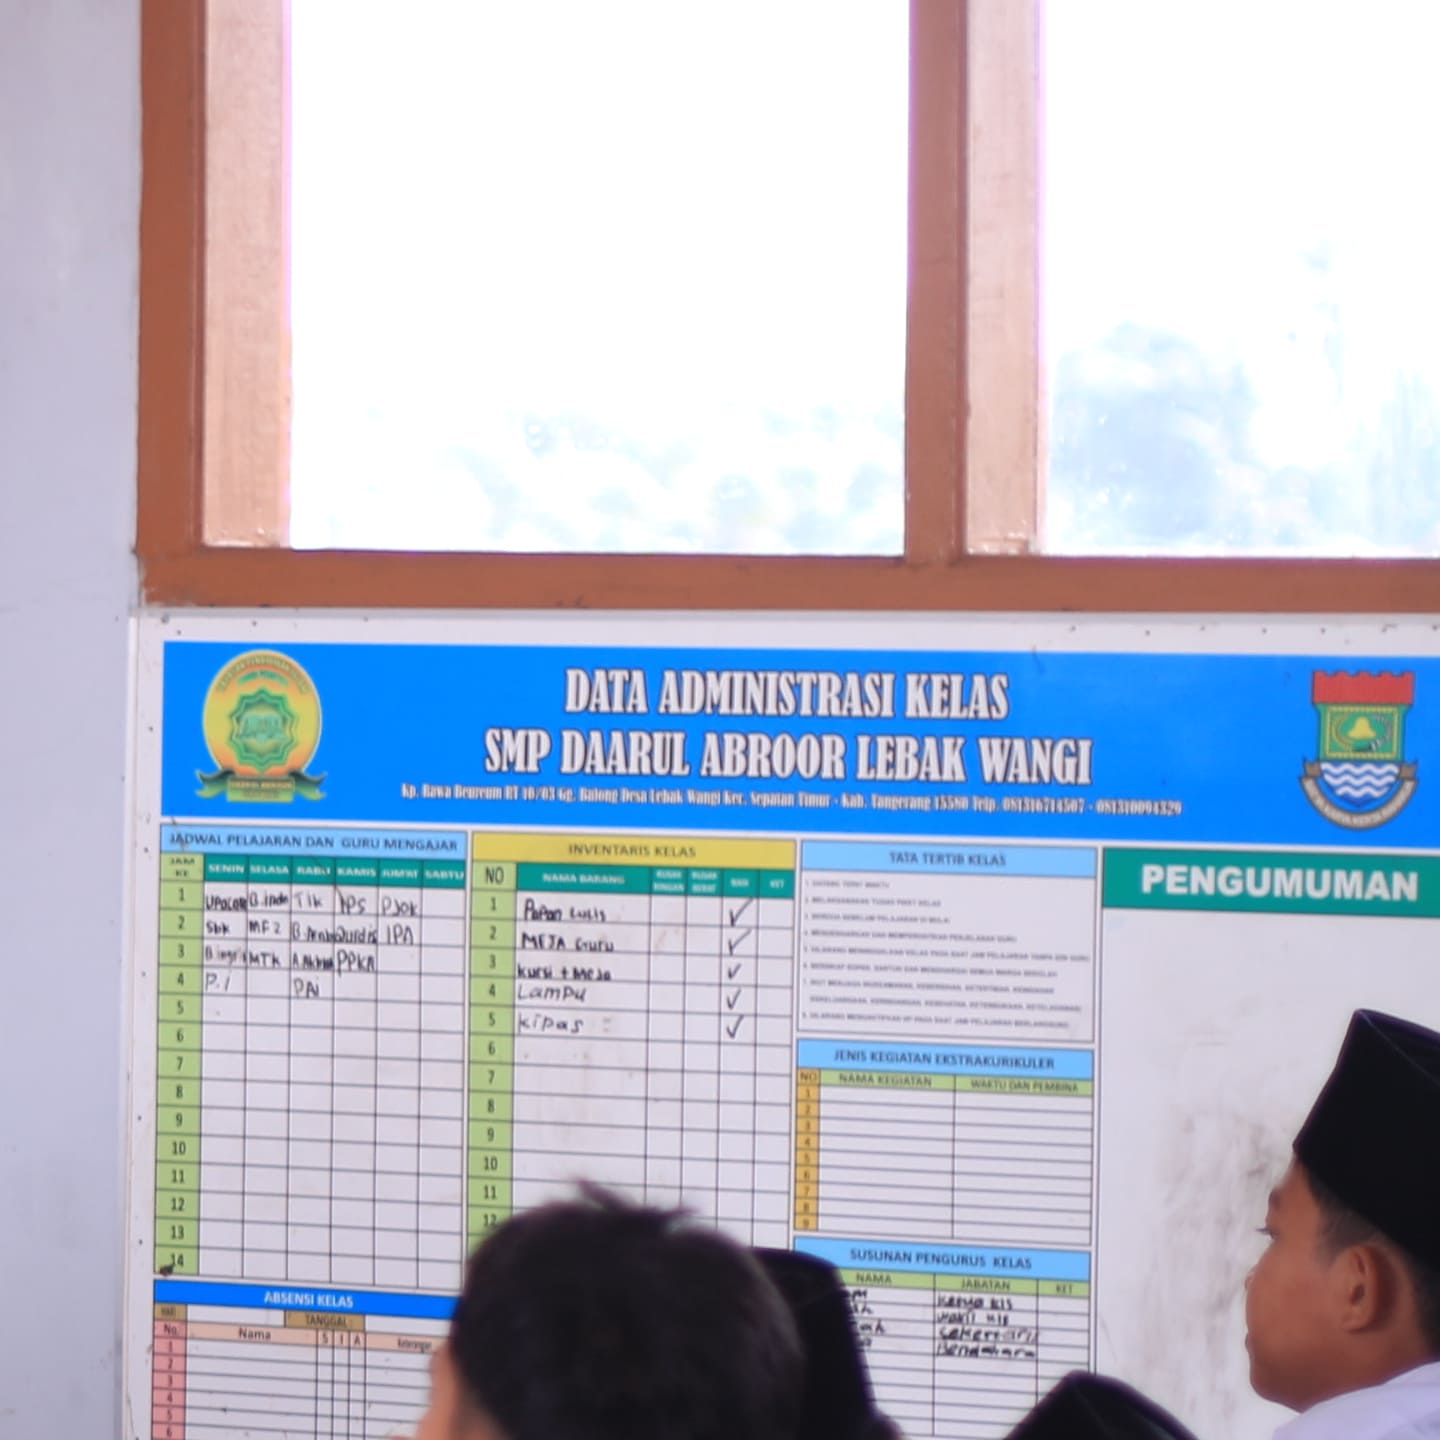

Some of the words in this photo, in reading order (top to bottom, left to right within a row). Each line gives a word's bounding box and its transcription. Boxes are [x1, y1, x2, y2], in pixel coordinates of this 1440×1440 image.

[564, 667, 649, 715] DATA
[658, 669, 896, 719] ADMINISTRASI
[904, 673, 1010, 720] KELAS
[484, 728, 553, 774] SMP
[560, 730, 691, 777] DAARUL
[700, 732, 847, 780] ABROOR
[856, 734, 967, 783] LEBAK
[977, 736, 1094, 785] WANGI
[621, 788, 647, 803] Desa
[650, 788, 683, 804] Lebak
[687, 789, 722, 806] Wangi
[724, 790, 747, 805] Kec.
[750, 790, 795, 808] Sepatan
[798, 791, 831, 807] Timur
[841, 791, 866, 808] Kab.
[871, 793, 932, 811] Tangerang
[170, 832, 223, 847] JADWAL
[227, 834, 303, 848] PELAJARAN
[306, 836, 334, 848] DAN
[341, 837, 380, 849] GURU
[384, 838, 458, 851] MENGAJAR
[569, 844, 650, 857] INVENTARIS
[654, 846, 697, 859] KELAS
[889, 851, 919, 864] TATA
[922, 852, 965, 866] TERTIB
[969, 854, 1007, 867] KELAS
[209, 863, 244, 874] SENIN
[249, 865, 289, 875] SELASA
[337, 868, 377, 878] KAMIS
[425, 870, 466, 881] SABTU
[484, 867, 505, 885] NO
[542, 872, 576, 883] NAMA
[1141, 863, 1419, 902] PENGUMUMAN
[178, 916, 185, 930] 2
[489, 926, 497, 940] 2
[177, 945, 184, 959] 3
[489, 955, 497, 969] 3
[177, 973, 184, 987] 4
[488, 984, 496, 998] 4
[176, 1000, 184, 1014] 5
[488, 1013, 496, 1027] 5
[176, 1029, 184, 1042] 6
[488, 1041, 496, 1055] 6
[176, 1057, 183, 1070] 7
[833, 1049, 867, 1062] JENIS
[870, 1051, 932, 1066] KEGIATAN
[935, 1054, 1056, 1070] EKSTRAKURIKULER
[487, 1070, 495, 1084] 7
[838, 1074, 874, 1085] NAMA
[877, 1076, 932, 1088] KEGIATAN
[176, 1085, 183, 1099] 8
[487, 1099, 495, 1113] 8
[175, 1113, 183, 1127] 9
[487, 1128, 495, 1142] 9
[171, 1141, 186, 1155] 10
[483, 1156, 498, 1170] 10
[171, 1170, 185, 1184] 11
[483, 1185, 497, 1199] 11
[171, 1197, 185, 1211] 12
[171, 1226, 185, 1240] 13
[170, 1254, 184, 1267] 14
[850, 1250, 912, 1264] SUSUNAN
[916, 1252, 986, 1267] PENGURUS
[993, 1256, 1032, 1269] KELAS
[856, 1273, 892, 1284] NAMA
[961, 1279, 1010, 1292] JABATAN
[264, 1291, 314, 1307] ABSENSI
[317, 1293, 354, 1308] KELAS
[238, 1328, 271, 1341] Nama
